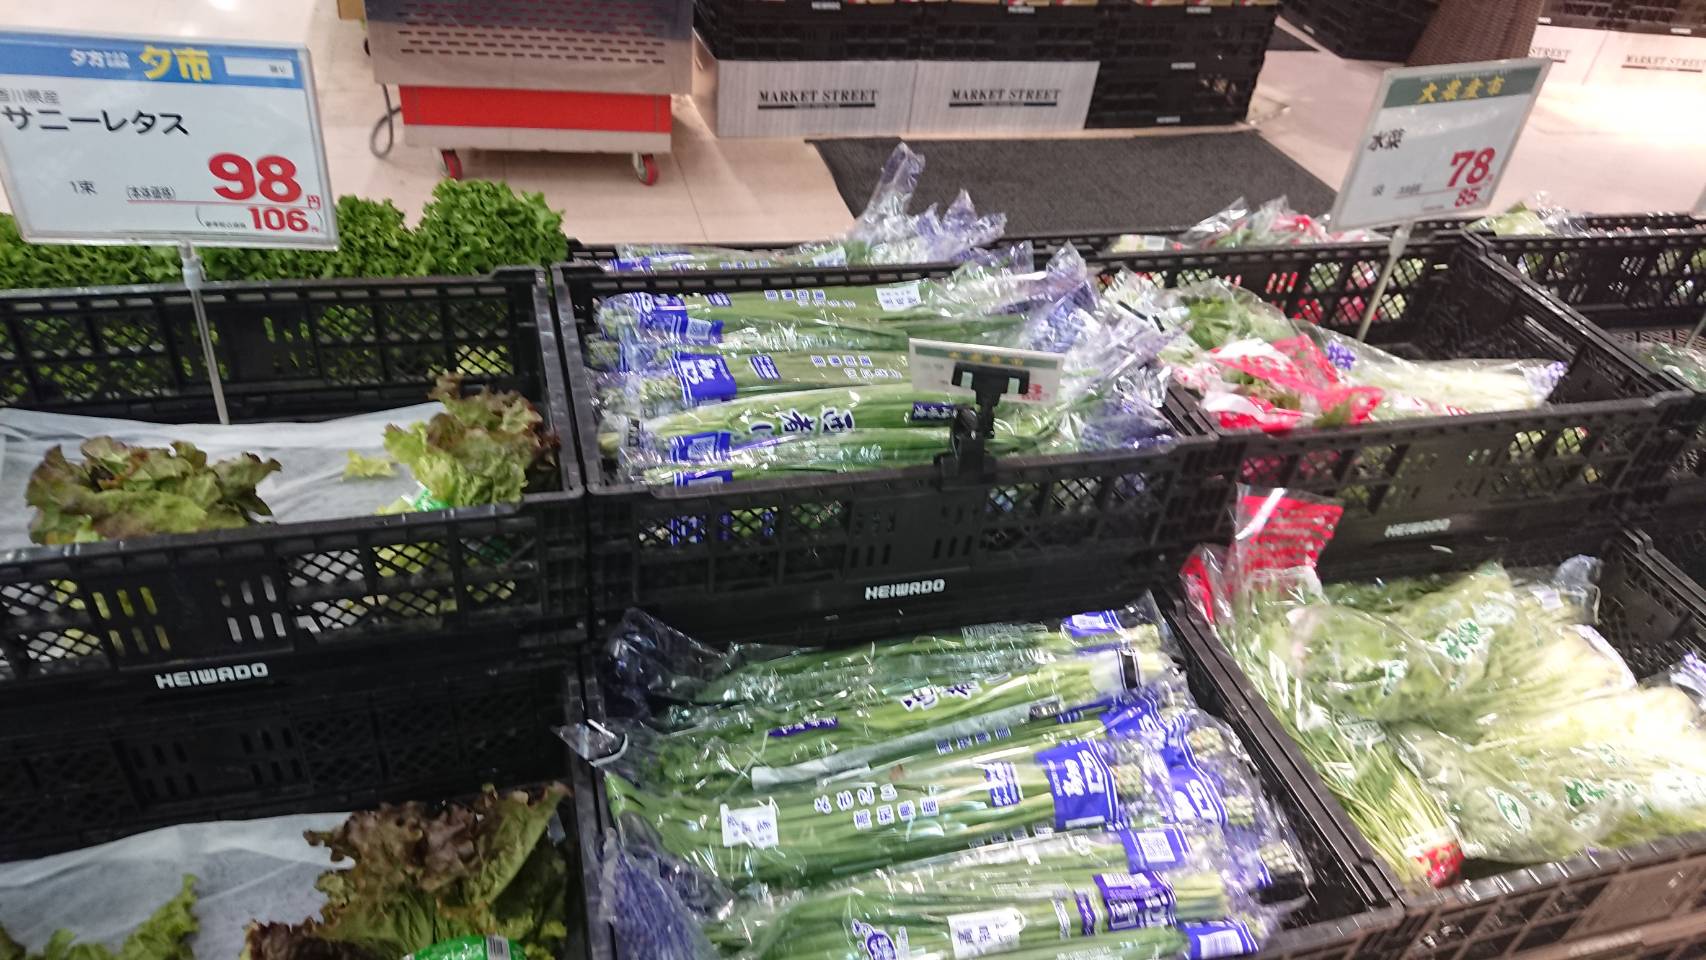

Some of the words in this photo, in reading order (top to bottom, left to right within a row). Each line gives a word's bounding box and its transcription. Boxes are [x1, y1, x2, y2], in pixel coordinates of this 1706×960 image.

[139, 45, 213, 81] 夕市
[759, 88, 817, 103] MARKET
[822, 88, 879, 102] STREET
[952, 88, 1005, 101] MARKET
[1008, 88, 1061, 101] STREET
[1, 106, 189, 136] サニーレタス
[1367, 128, 1404, 151] 水菜
[1447, 147, 1496, 188] 78
[864, 578, 947, 601] HEIWADO
[154, 662, 270, 690] HEIWADO
